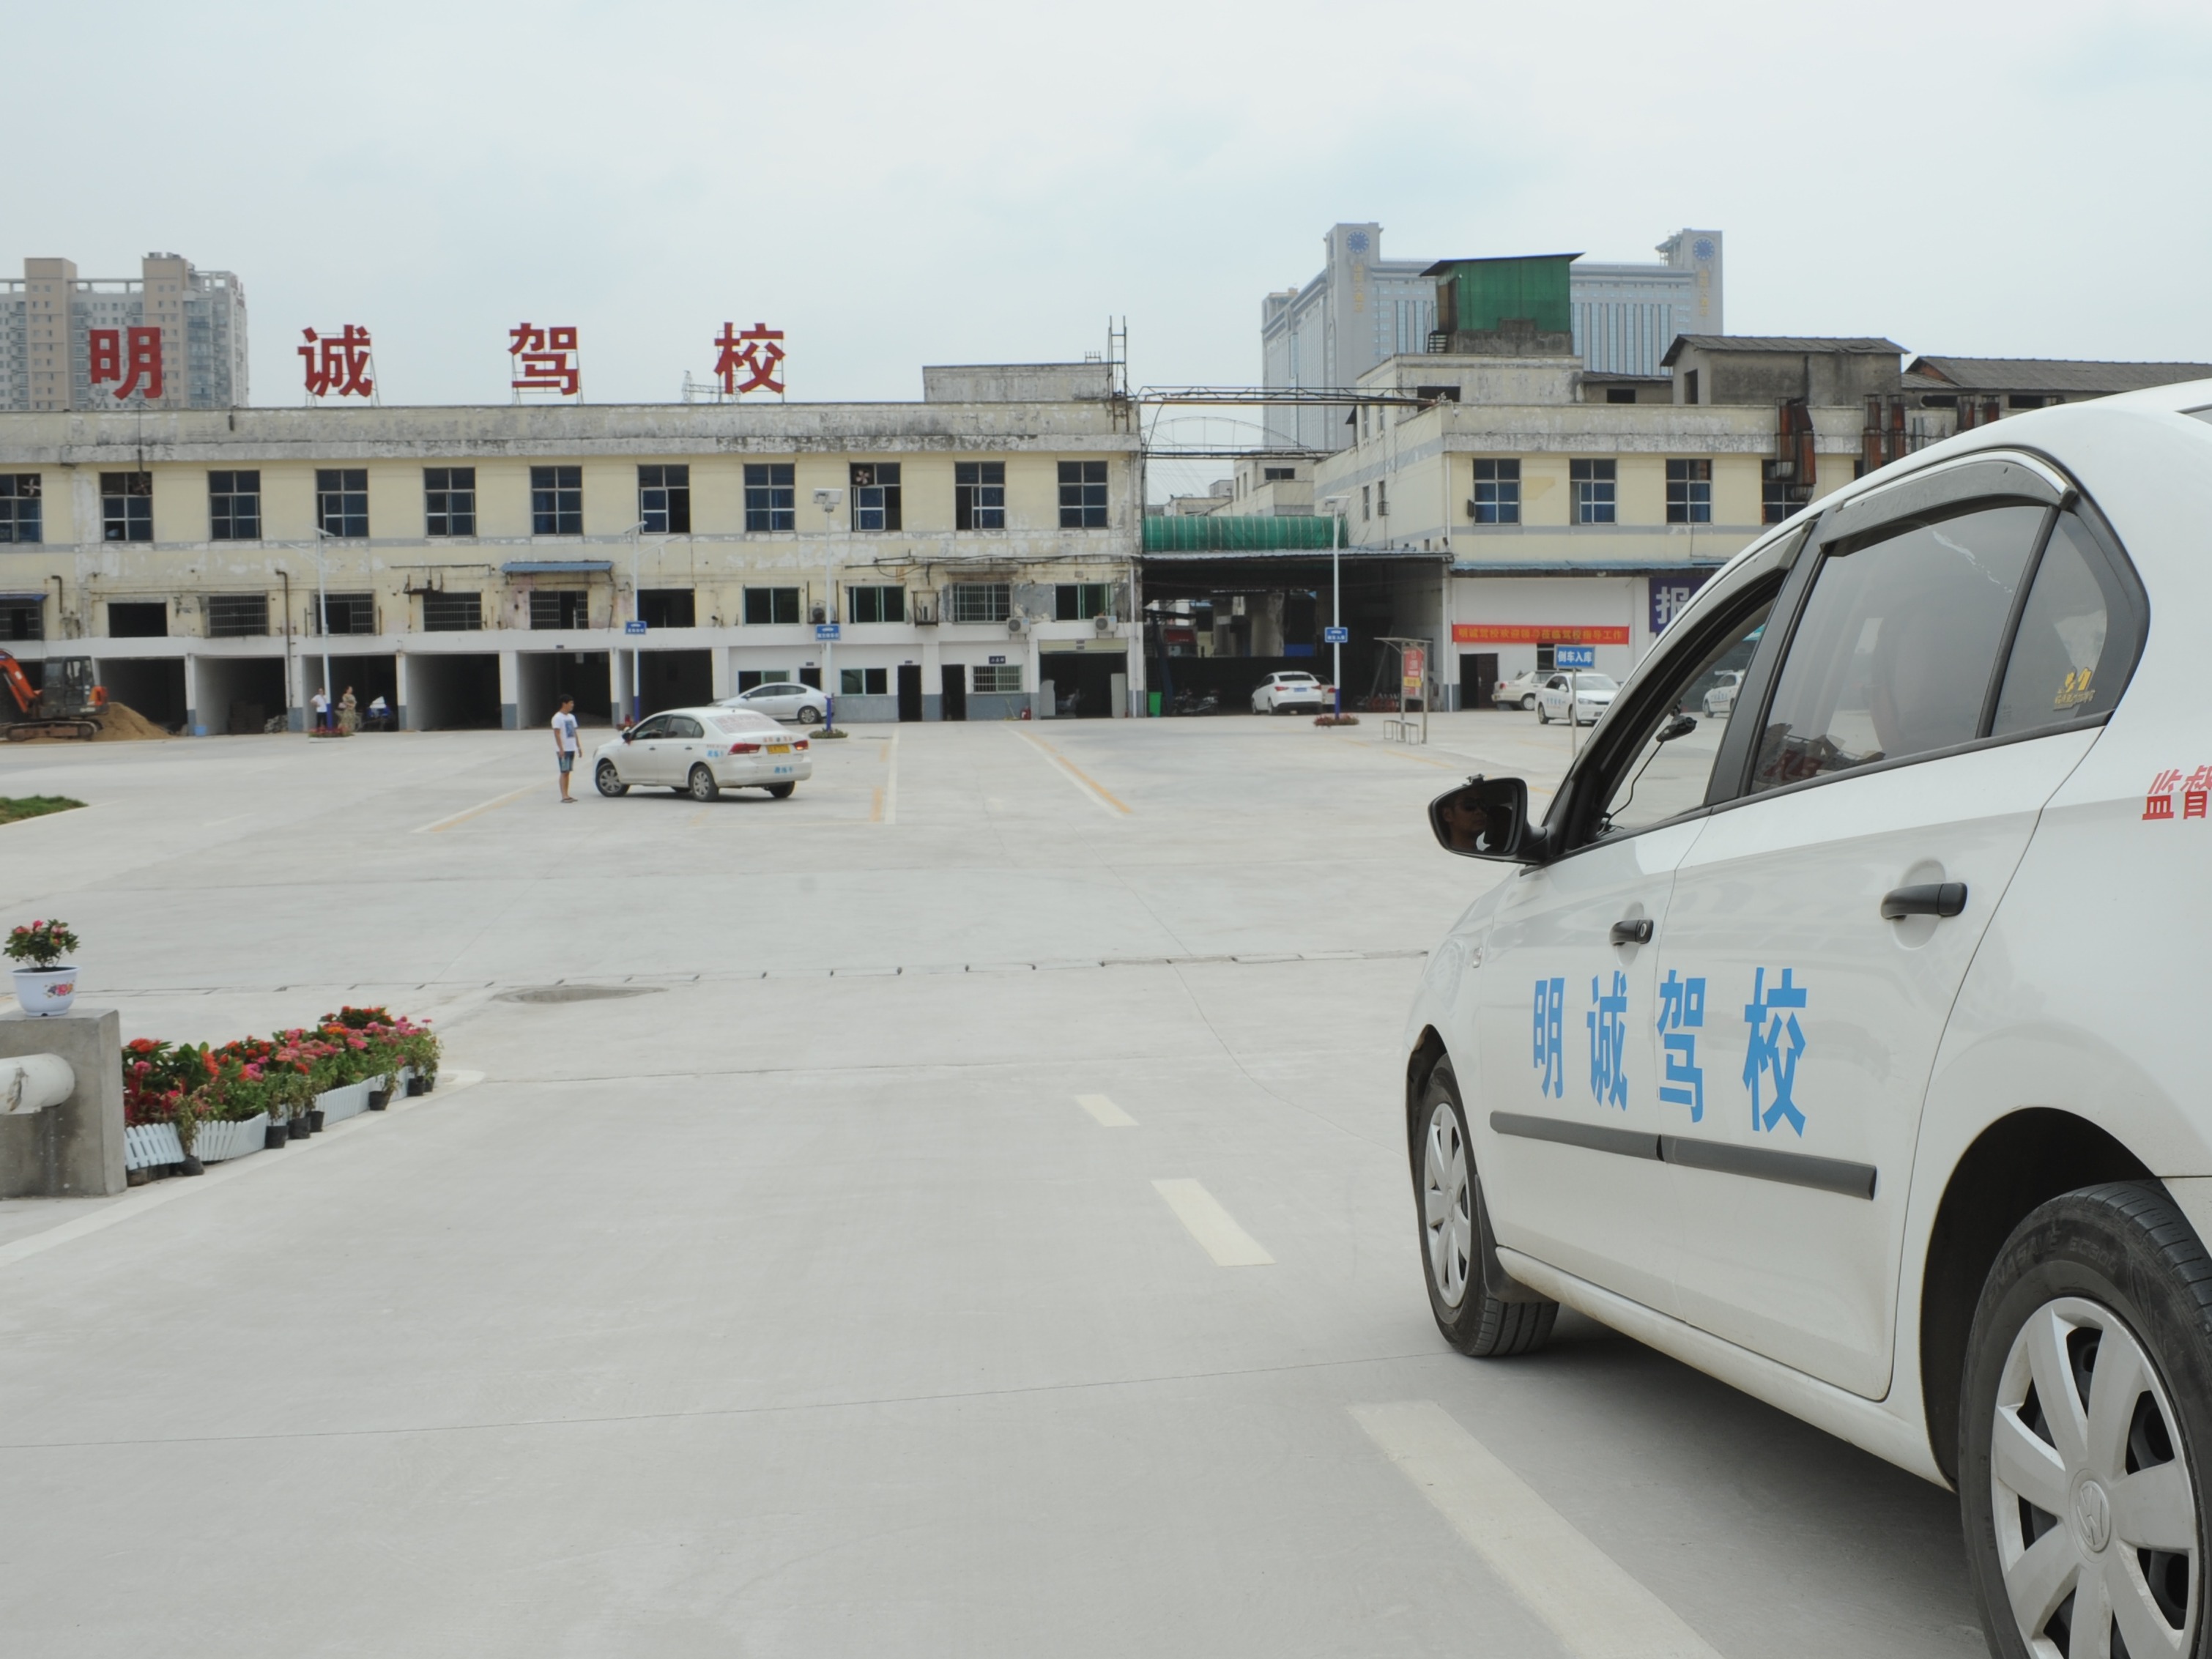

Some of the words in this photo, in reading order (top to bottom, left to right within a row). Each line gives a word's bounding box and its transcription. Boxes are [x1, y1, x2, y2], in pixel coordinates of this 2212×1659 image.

[89, 322, 786, 399] 明诚驾校
[1557, 650, 1592, 664] 倒车入库
[2142, 765, 2212, 820] 监督
[1533, 967, 1807, 1138] 明诚驾校
